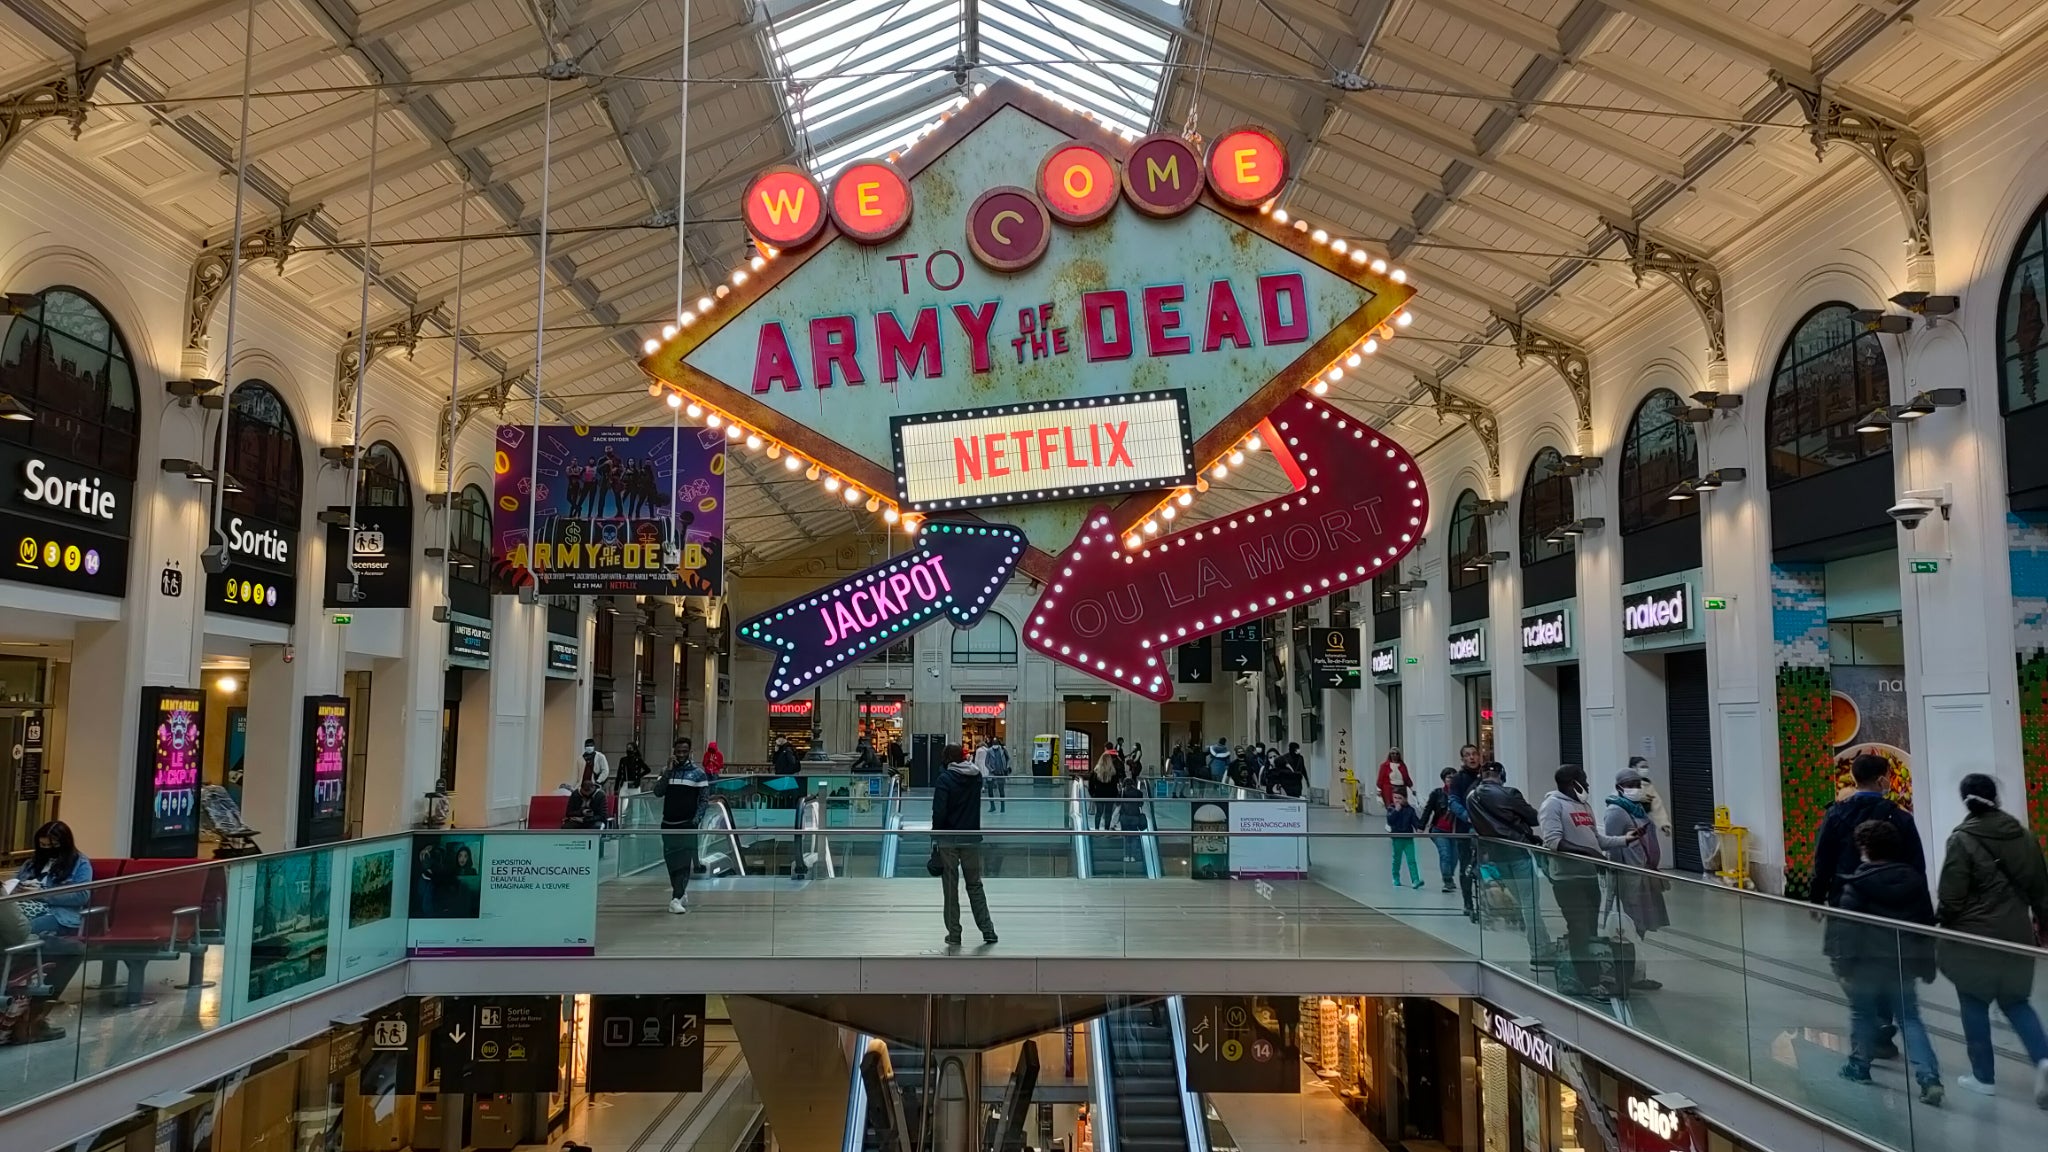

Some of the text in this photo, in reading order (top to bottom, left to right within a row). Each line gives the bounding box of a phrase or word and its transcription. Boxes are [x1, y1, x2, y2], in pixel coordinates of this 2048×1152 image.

[886, 250, 965, 294] TO
[1018, 302, 1055, 335] OF
[1082, 271, 1311, 363] DEAD
[751, 301, 1000, 395] ARMY
[1011, 327, 1070, 363] THE
[953, 420, 1135, 485] NETFLIX
[24, 459, 115, 519] Sortie
[229, 517, 288, 563] Sortie
[603, 545, 617, 556] OF
[47, 546, 57, 563] 3
[69, 551, 76, 566] 9
[86, 554, 99, 571] 14
[513, 543, 600, 569] ARMY
[599, 556, 620, 567] THE
[624, 543, 702, 569] DED
[1070, 496, 1383, 638] OU LA MORT
[609, 581, 637, 590] NETFLIX
[820, 555, 951, 646] JACKPOT
[1625, 590, 1684, 631] naked
[1228, 630, 1235, 639] 1
[1248, 631, 1256, 639] 5
[1523, 615, 1563, 648] naked
[1450, 632, 1479, 660] naked
[1372, 649, 1393, 672] naked
[161, 700, 180, 711] ARMY
[172, 752, 184, 767] LE
[491, 866, 591, 876] LES FRANCISCAINES
[507, 1007, 530, 1016] Sortie
[1230, 1011, 1242, 1022] M
[613, 1023, 623, 1040] L
[1495, 1014, 1553, 1072] SWAROVSKI
[483, 1045, 496, 1054] BUS
[1228, 1044, 1271, 1057] 9 14
